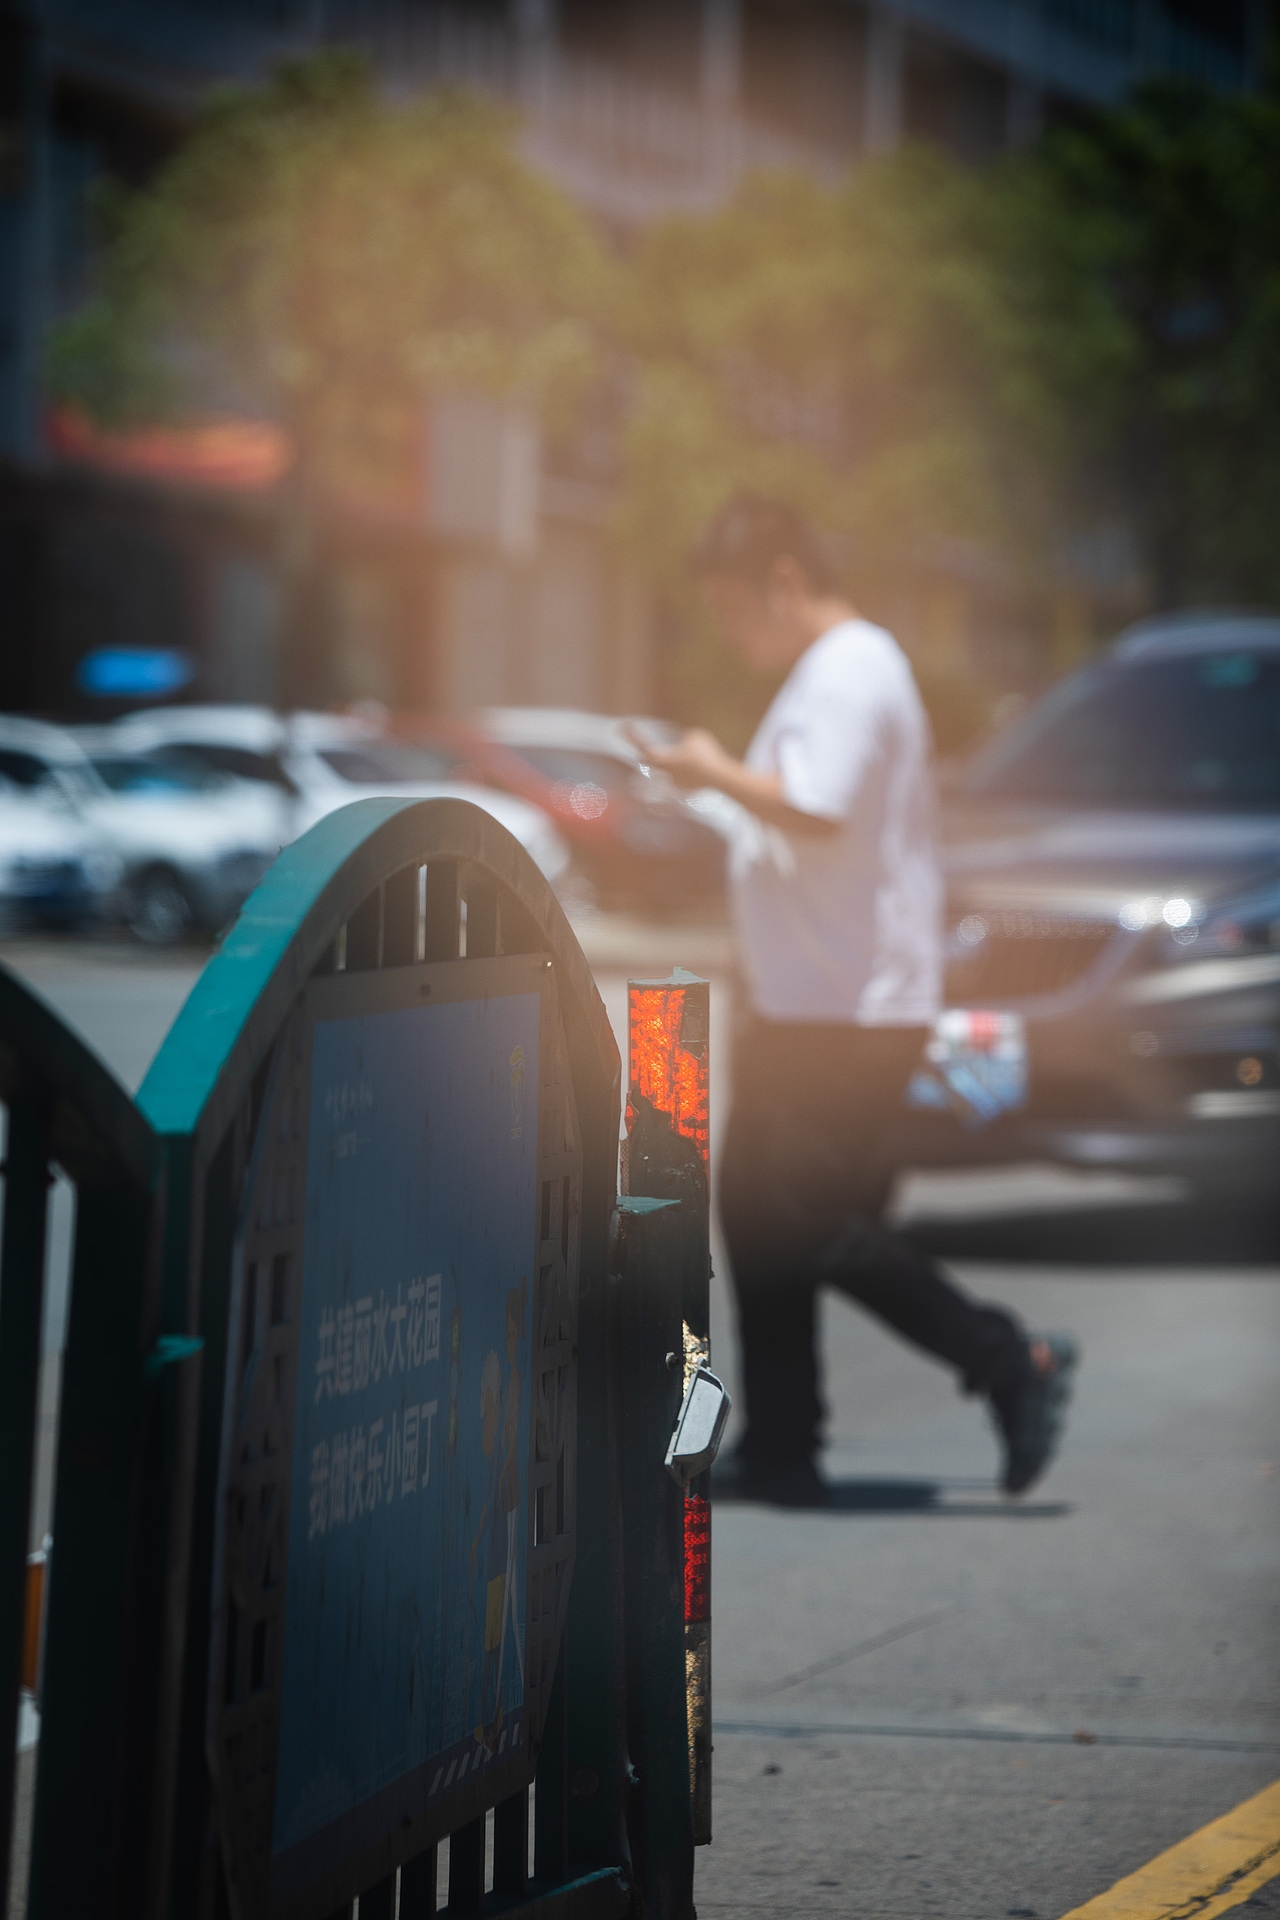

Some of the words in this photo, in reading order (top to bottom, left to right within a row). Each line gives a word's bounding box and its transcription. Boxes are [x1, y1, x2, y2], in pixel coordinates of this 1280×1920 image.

[313, 1273, 442, 1404] 共建丽水大花园
